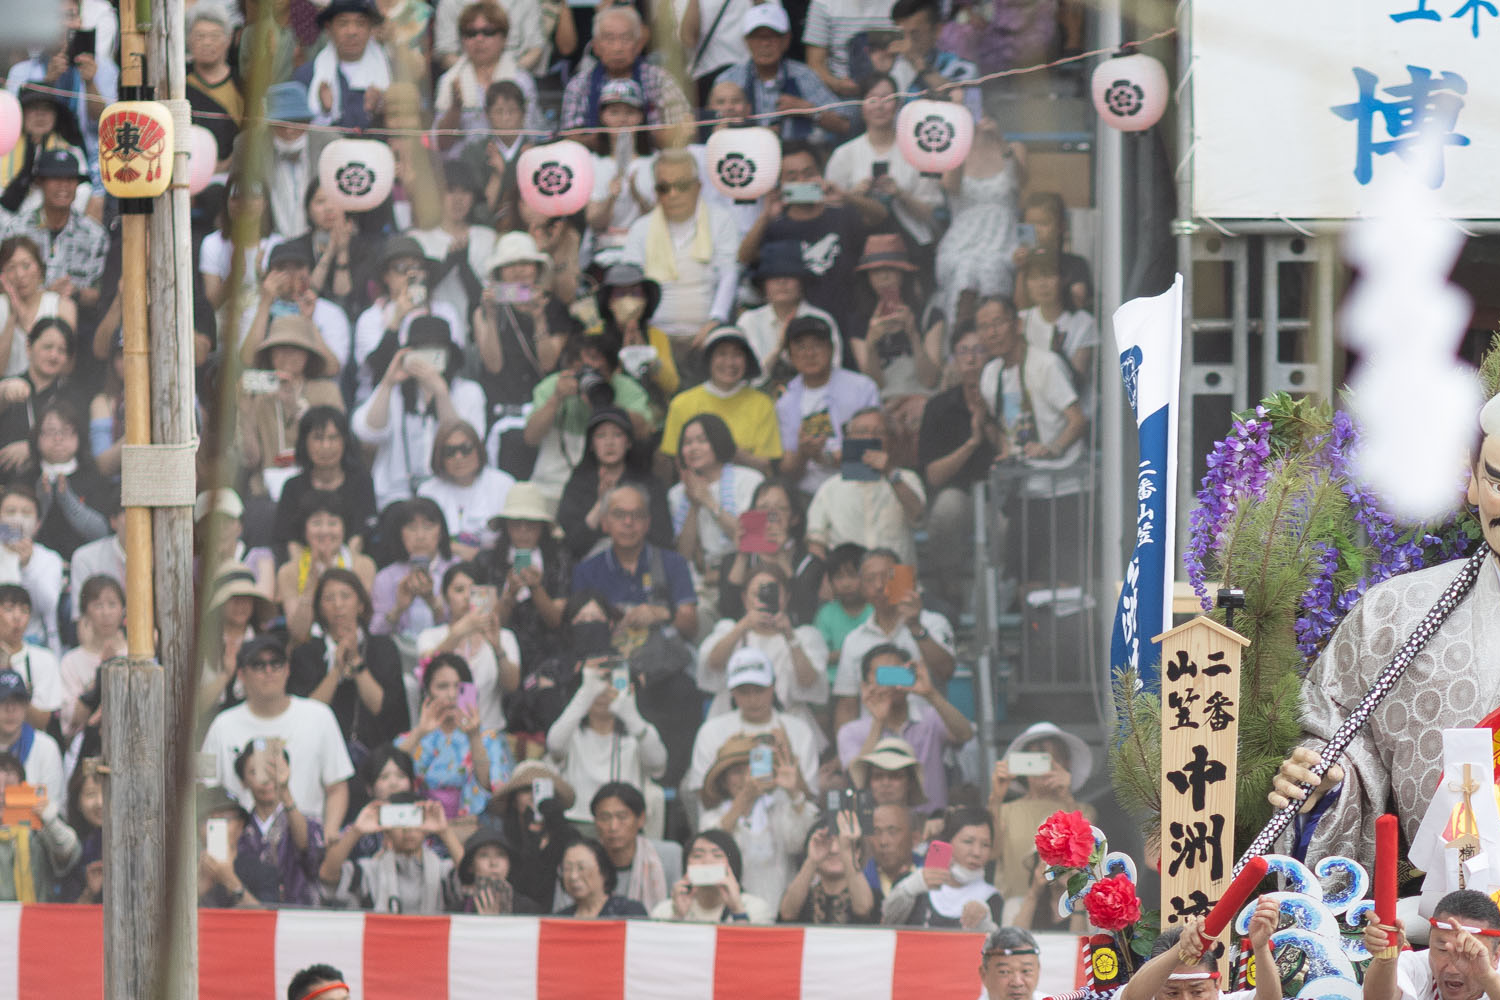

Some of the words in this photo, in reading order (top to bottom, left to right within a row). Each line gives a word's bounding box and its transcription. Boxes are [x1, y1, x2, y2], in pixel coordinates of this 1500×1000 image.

[113, 121, 144, 155] 東
[1167, 650, 1200, 731] 山笠
[1202, 651, 1235, 732] 二番
